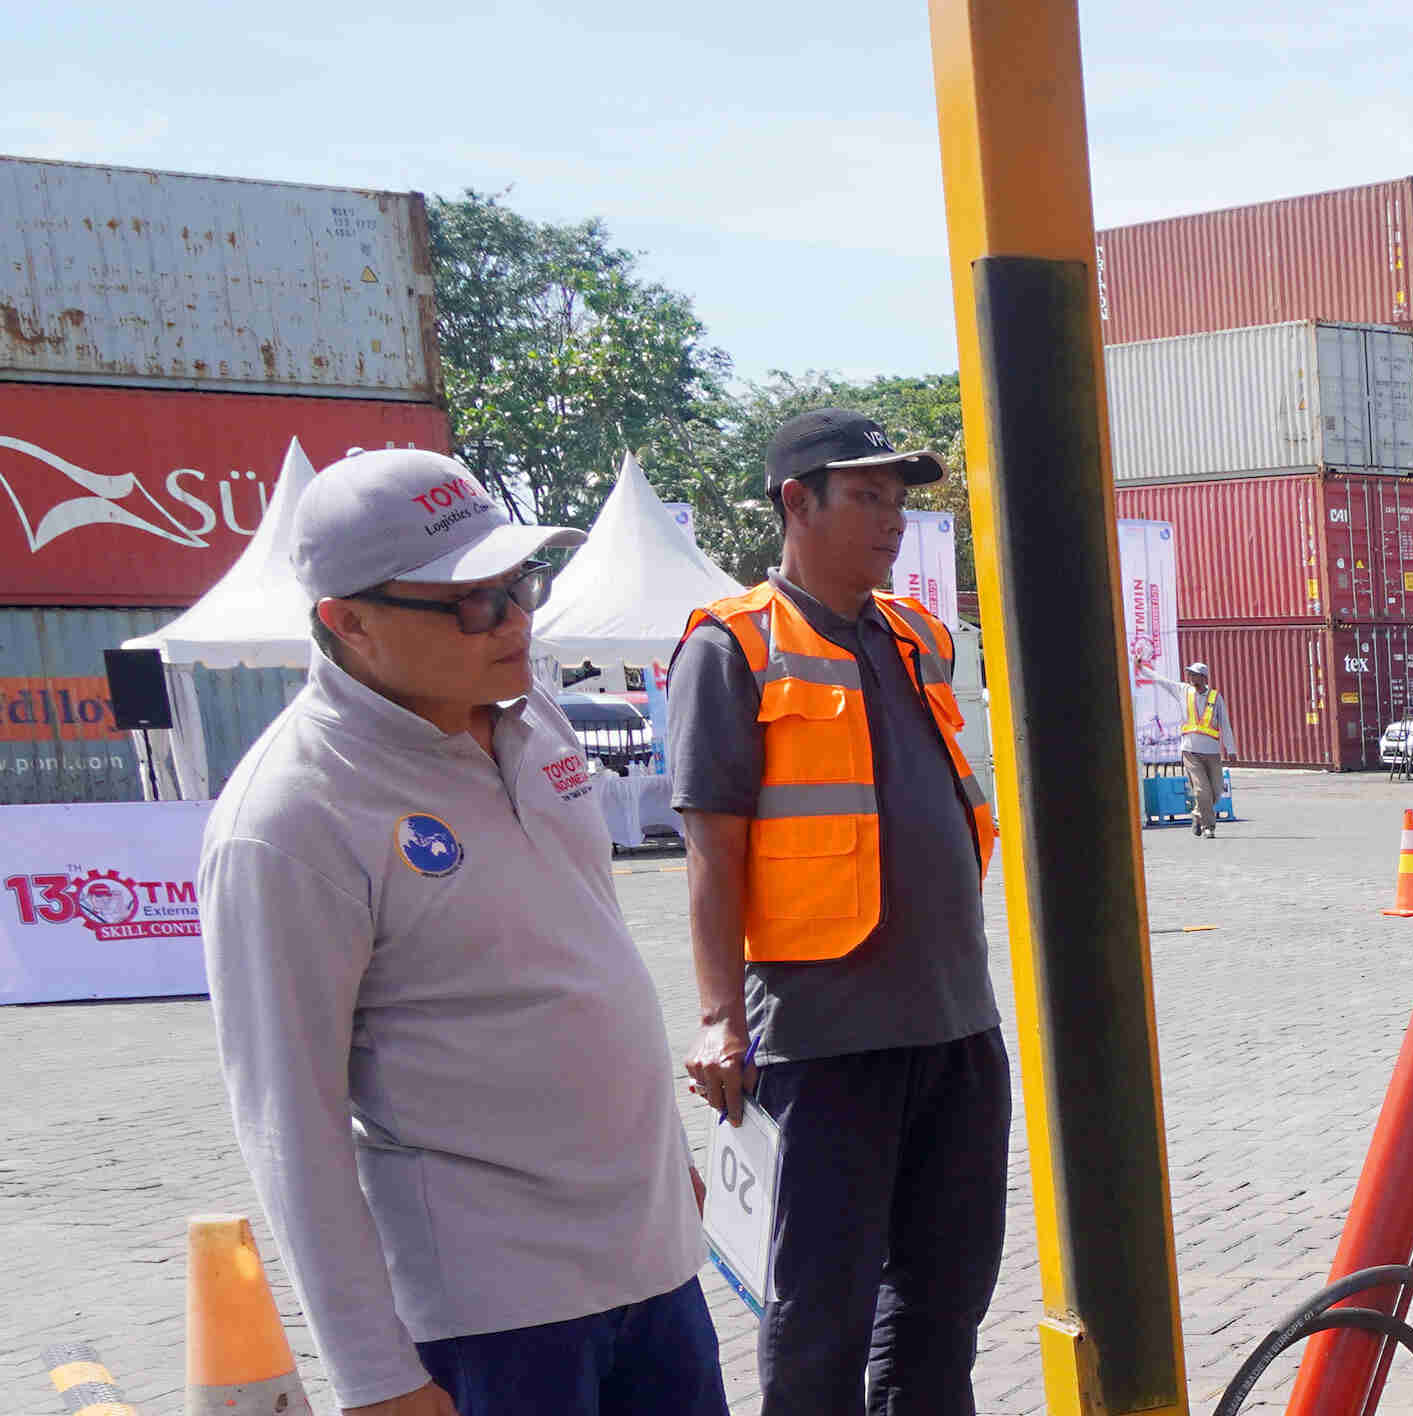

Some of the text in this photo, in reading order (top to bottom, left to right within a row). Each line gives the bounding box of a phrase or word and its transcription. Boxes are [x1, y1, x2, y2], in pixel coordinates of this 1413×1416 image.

[424, 508, 472, 536] Logistics
[1344, 653, 1369, 672] tex
[5, 864, 82, 925] 13 TH
[143, 904, 201, 918] Externa
[102, 924, 147, 938] SKILL
